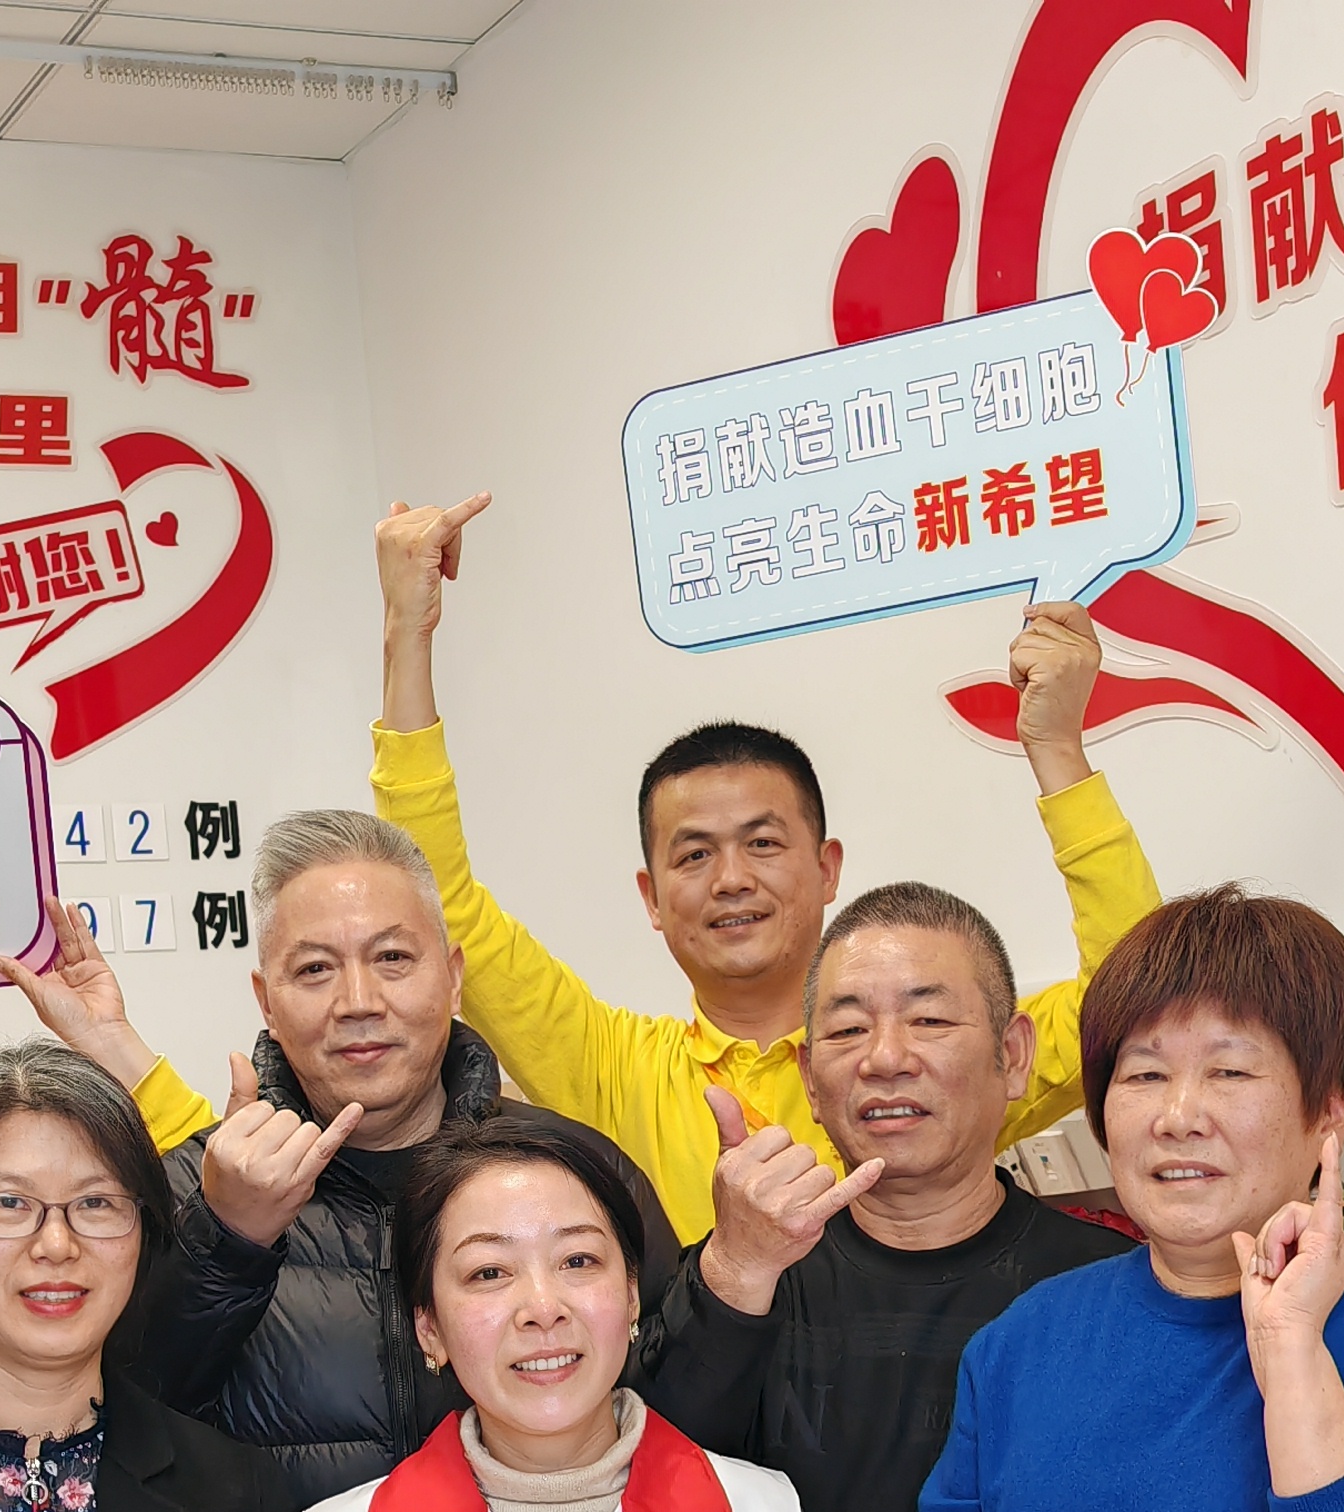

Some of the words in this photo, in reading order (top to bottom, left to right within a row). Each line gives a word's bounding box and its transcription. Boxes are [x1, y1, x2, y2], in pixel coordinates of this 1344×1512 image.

[656, 341, 1102, 506] 捐献造血干细胞
